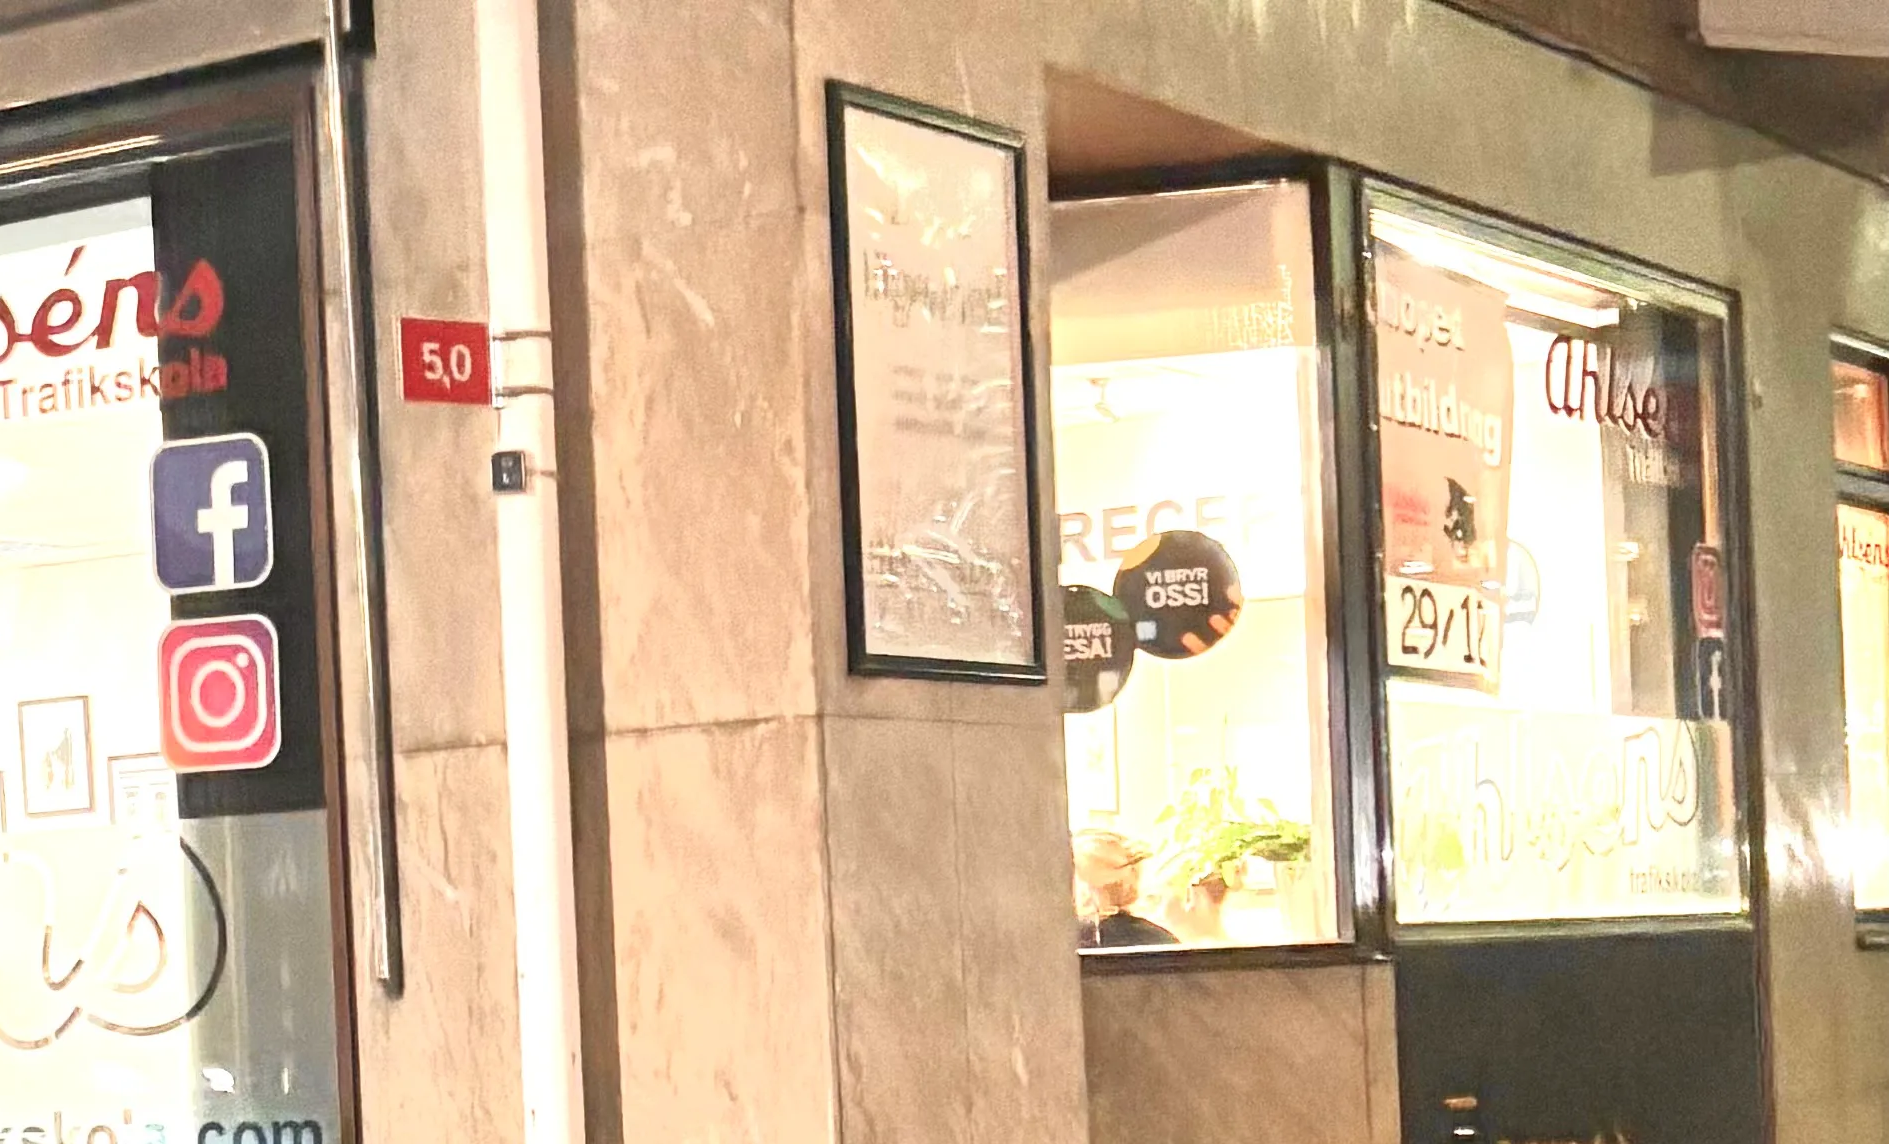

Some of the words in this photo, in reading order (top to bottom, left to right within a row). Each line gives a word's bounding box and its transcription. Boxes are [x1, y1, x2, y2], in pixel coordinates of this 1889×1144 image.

[1545, 334, 1699, 446] Ahlse
[1145, 571, 1162, 585] VI
[1164, 567, 1209, 584] BRYR
[1145, 583, 1209, 610] OSS!
[1063, 637, 1112, 661] ESA!
